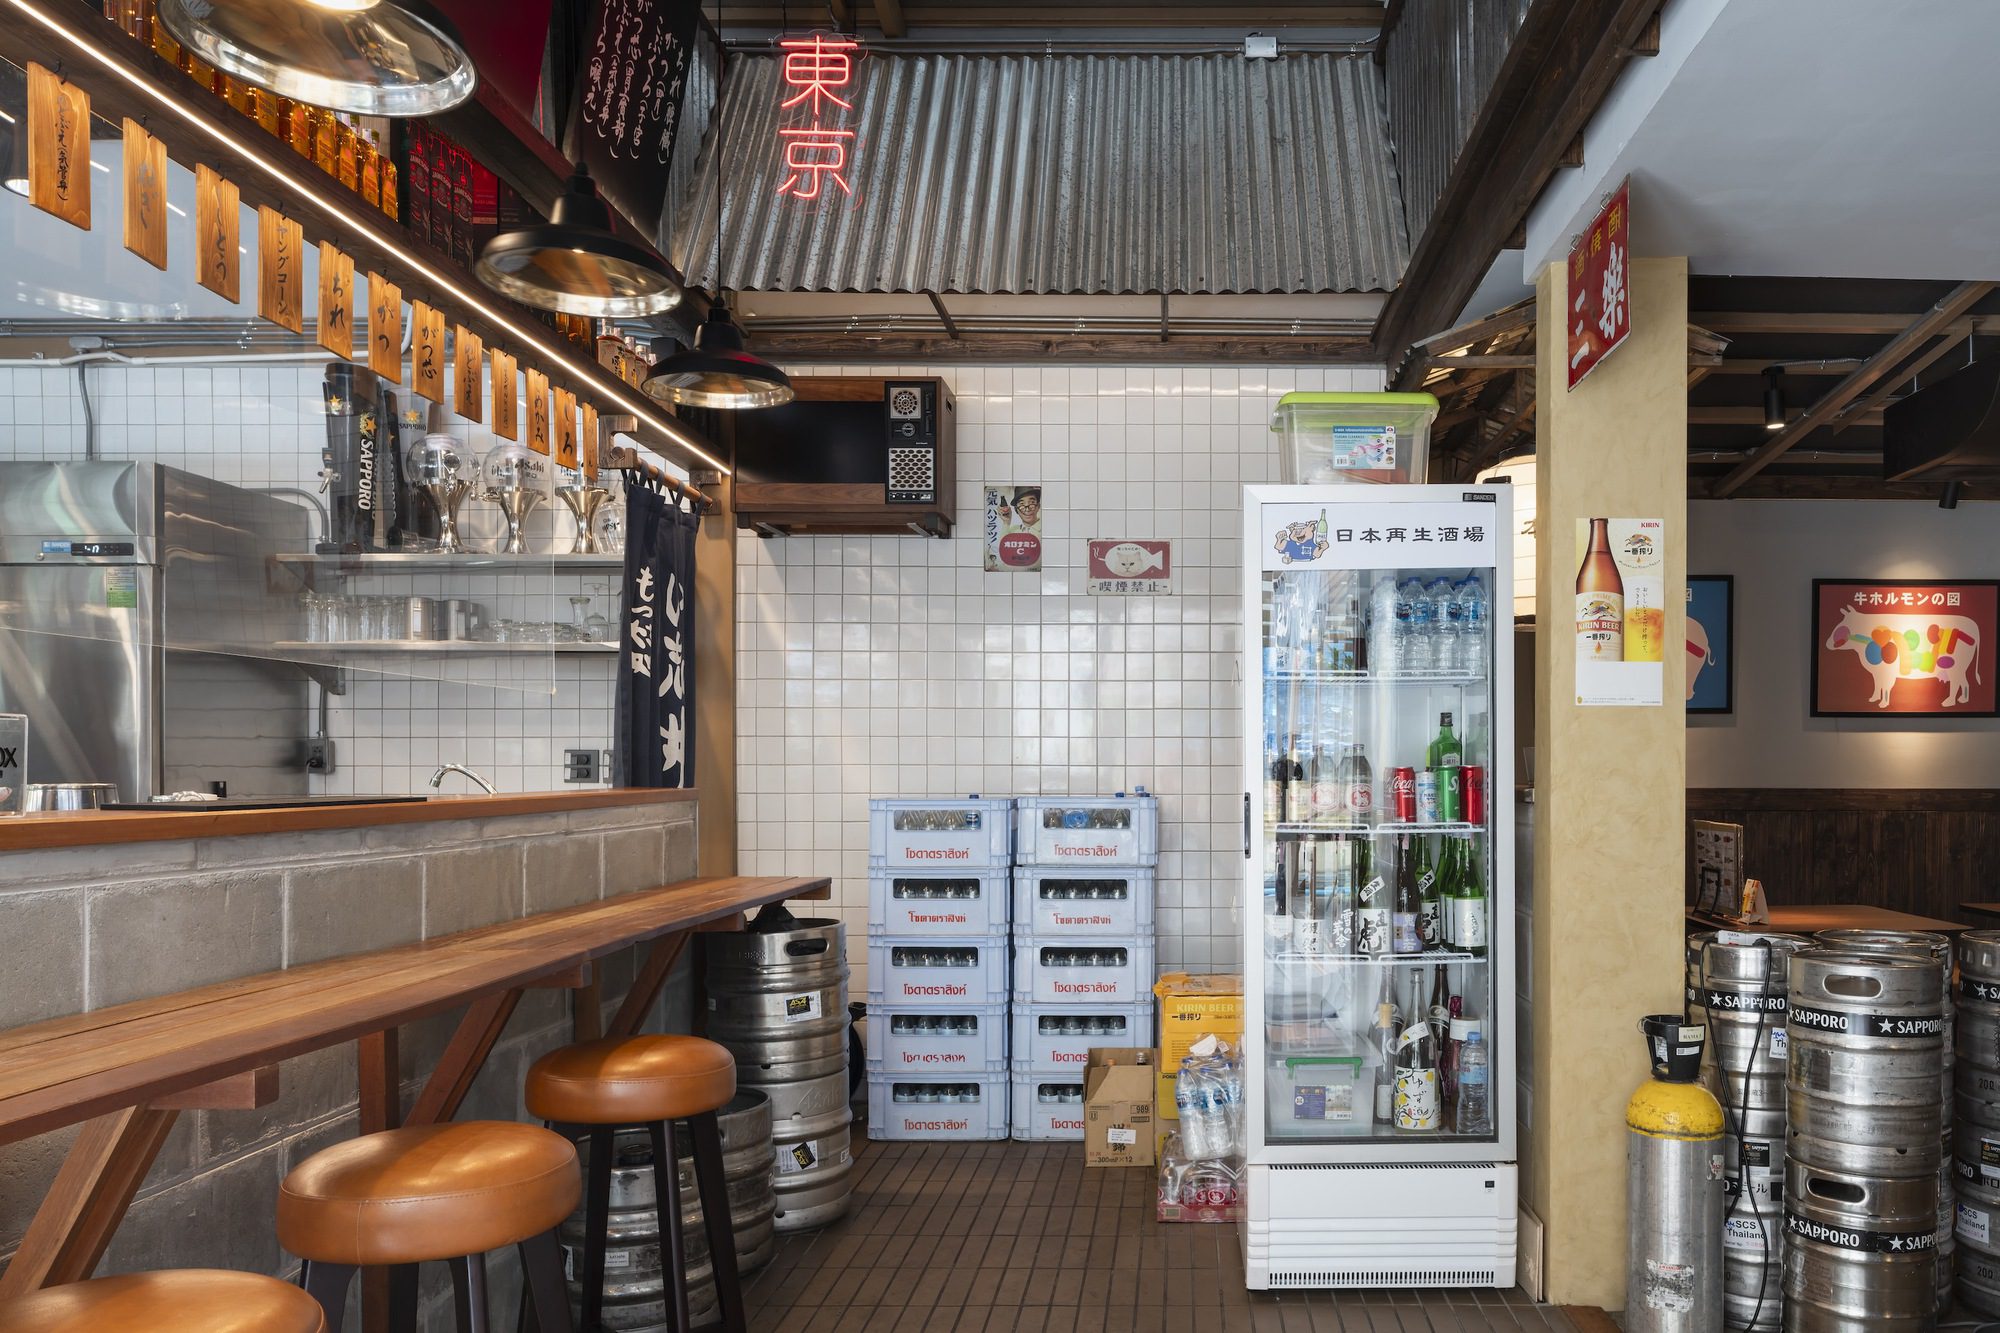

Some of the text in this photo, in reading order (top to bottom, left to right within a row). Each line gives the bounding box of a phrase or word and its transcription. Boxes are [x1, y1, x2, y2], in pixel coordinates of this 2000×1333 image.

[777, 36, 858, 198] 東京
[358, 438, 374, 511] SAPPORO
[1473, 493, 1494, 502] SANDEN
[1336, 526, 1485, 544] 日本再生酒場
[1098, 580, 1160, 593] 喫煙禁止
[1853, 591, 1960, 607] 牛ホルモンの図
[1578, 621, 1620, 630] KIRIN BEER
[1586, 633, 1612, 641] 一番搾り
[905, 847, 970, 859] โซดาตราสิงห์
[1054, 844, 1118, 857] โซดาตราสิงห์
[904, 983, 967, 996] โซดาตราสิงห์
[1054, 981, 1117, 993] โซดาตราสิงห์
[1176, 1003, 1234, 1012] KIRIN BEER
[1795, 1009, 1849, 1030] SAPPORO
[1136, 1105, 1149, 1114] 989
[904, 1119, 968, 1131] โซดาตราสิงห์
[1735, 1220, 1757, 1230] SCS
[1798, 1220, 1860, 1248] SAPPORO
